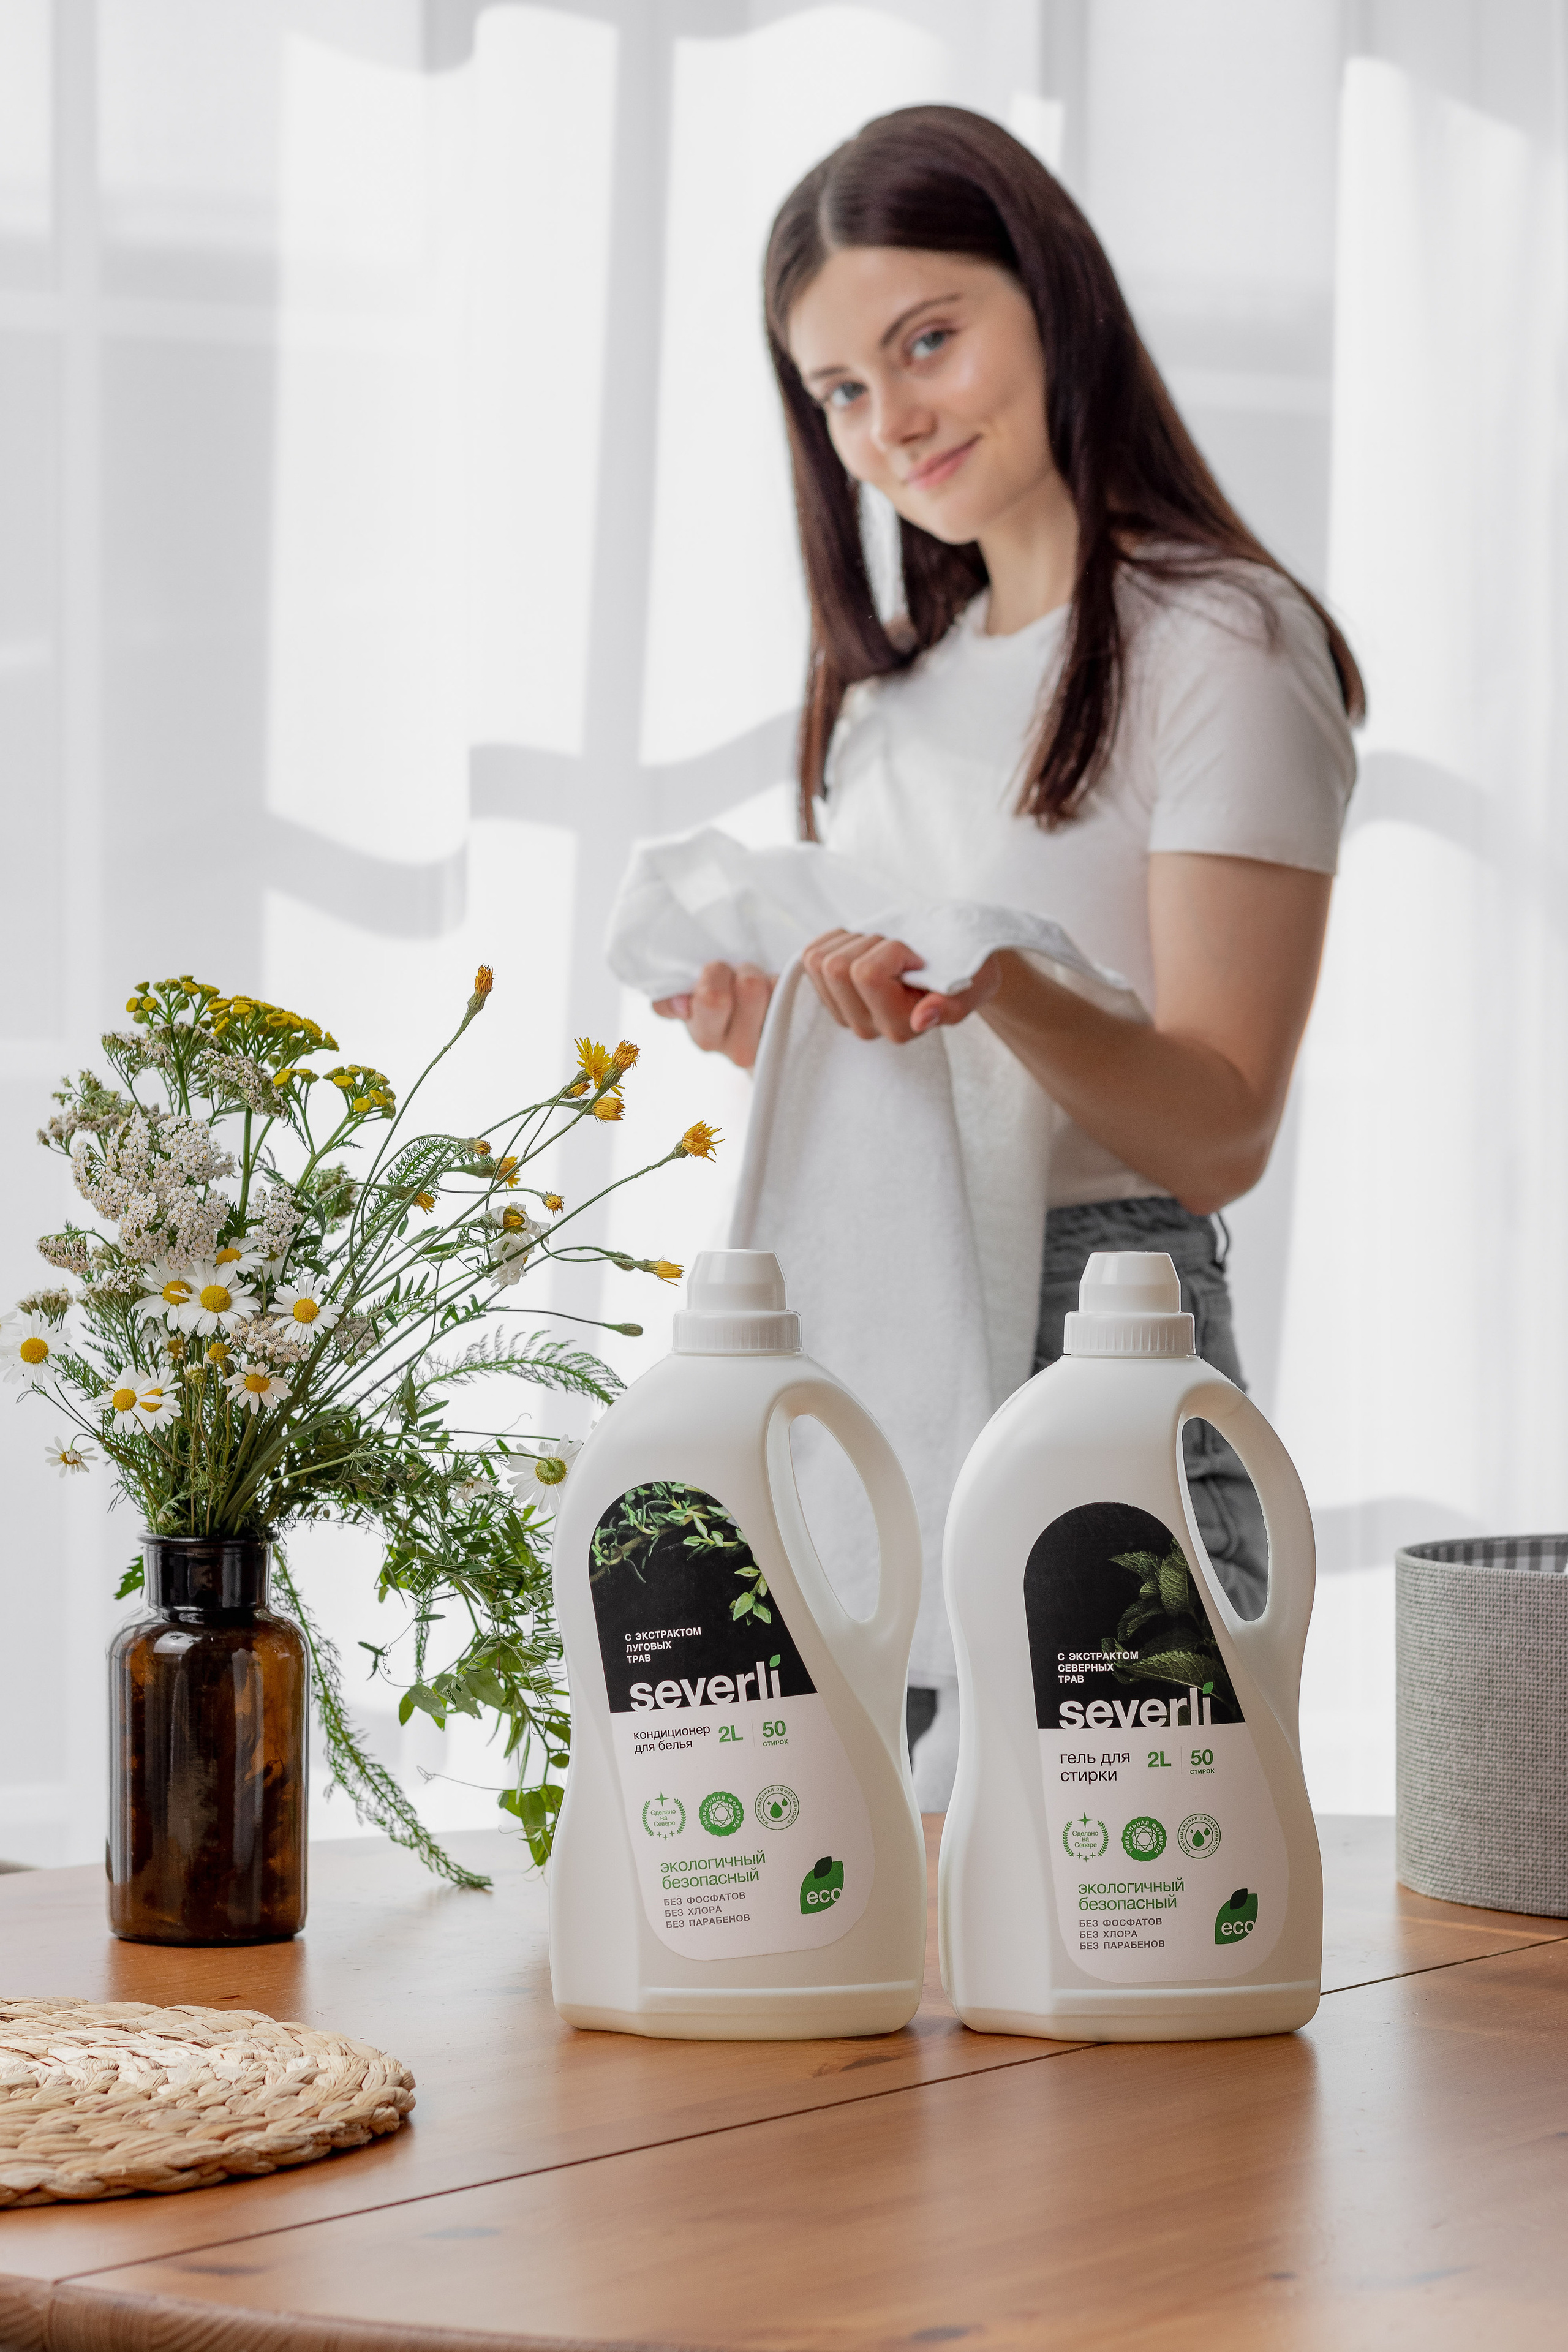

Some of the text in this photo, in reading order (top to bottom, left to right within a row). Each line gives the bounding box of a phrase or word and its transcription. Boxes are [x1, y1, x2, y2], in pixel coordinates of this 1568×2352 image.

[625, 1627, 701, 1642] С ЭКСТРАКТОМ
[626, 1641, 672, 1653] ЛУГОВЫХ
[627, 1654, 651, 1664] ТРАВ
[1069, 1651, 1139, 1660] ЭКСТРАКТОМ
[1058, 1662, 1114, 1672] СЕВЕРНЫХ
[630, 1654, 781, 1712] severli
[1058, 1675, 1084, 1683] ТРАВ
[1058, 1681, 1213, 1730] severli
[633, 1725, 710, 1741] кондиционер
[718, 1725, 743, 1743] 2L
[763, 1721, 786, 1738] 50
[635, 1739, 693, 1754] для белья
[1060, 1752, 1131, 1766] гель для
[1147, 1751, 1172, 1768] 2L
[1190, 1749, 1213, 1766] 50
[1060, 1770, 1117, 1785] стирки
[650, 1809, 676, 1817] Сделано
[701, 1795, 741, 1829] УНИКАЛЬНАЯ ФОРМУЛА
[758, 1787, 797, 1825] МАКСИМАЛЬНАЯ ЭФФЕКТИВНОСТЬ
[1125, 1820, 1164, 1853] УНИКАЛЬНАЯ ФОРМУЛА
[1180, 1817, 1219, 1853] МАКСИМАЛЬНАЯ ЭФФЕКТИВНОСТЬ
[660, 1850, 766, 1873] экологичный
[662, 1868, 760, 1889] безопасный
[1078, 1877, 1185, 1894] экологичный
[663, 1891, 745, 1906] БЕЗ ФОСФАТОВ
[806, 1887, 842, 1905] eco
[1079, 1894, 1177, 1911] безопасный
[665, 1905, 722, 1917] БЕЗ ХЛОРА
[666, 1913, 750, 1928] БЕЗ ПАРАБЕНОВ
[1102, 1917, 1163, 1927] ФОСФАТОВ
[1221, 1920, 1256, 1936] eco
[1102, 1929, 1137, 1938] ХЛОРА
[1103, 1940, 1165, 1949] ПАРАБЕНОВ
